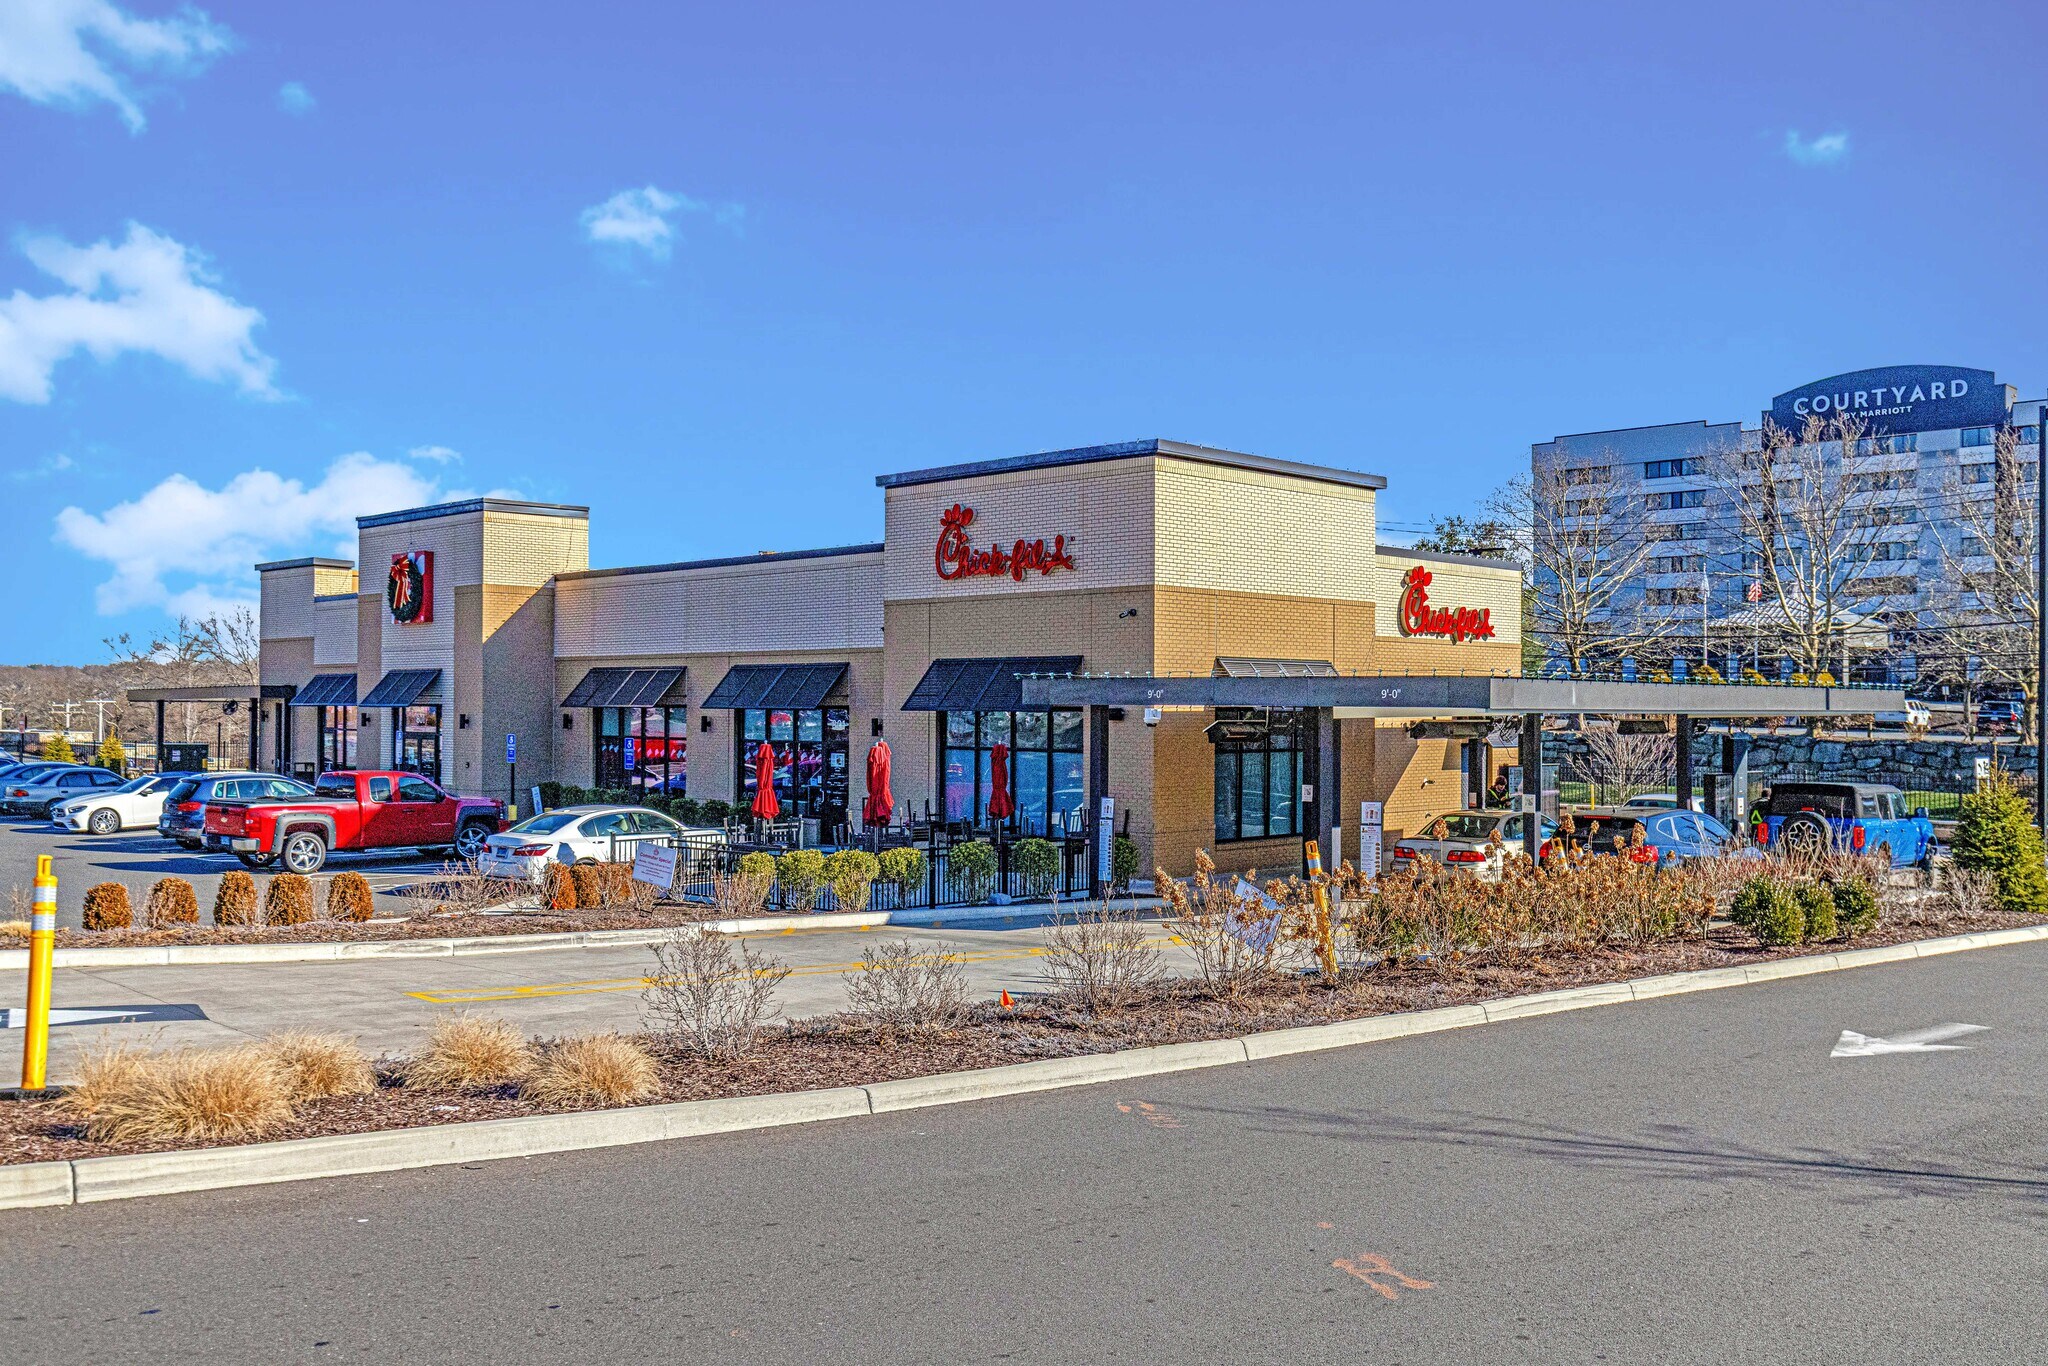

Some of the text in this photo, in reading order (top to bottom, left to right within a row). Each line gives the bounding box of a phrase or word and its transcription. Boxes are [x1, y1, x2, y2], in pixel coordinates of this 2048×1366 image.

[1793, 379, 1969, 415] COURTYARD
[1844, 405, 1913, 420] BY MARRIOTT
[935, 503, 1074, 582] Chick-fil-A
[1380, 688, 1402, 699] 9'-0"
